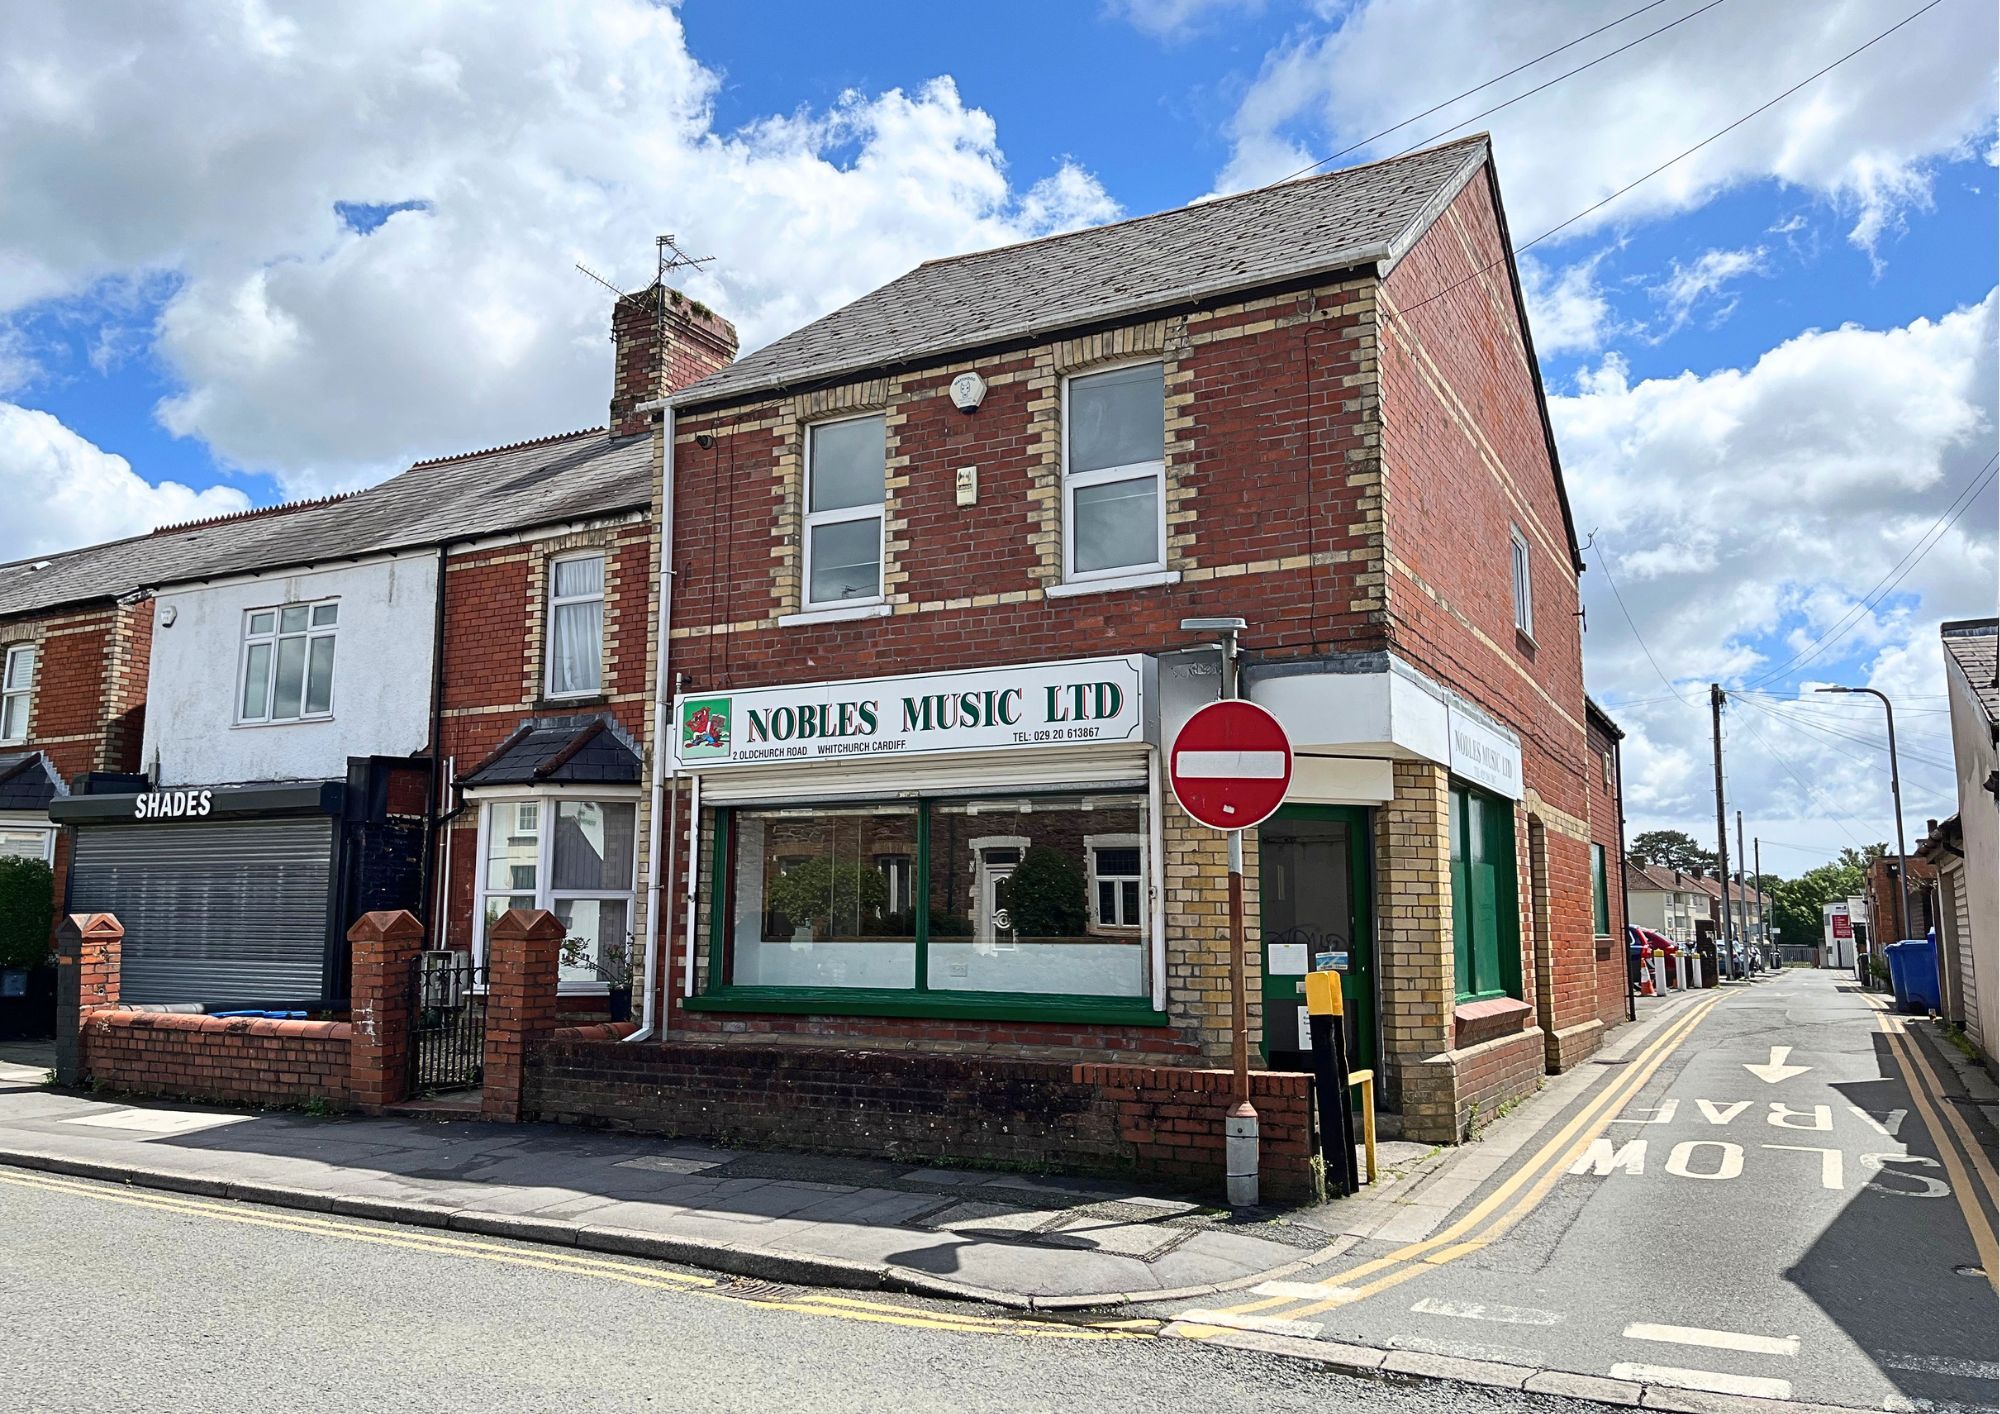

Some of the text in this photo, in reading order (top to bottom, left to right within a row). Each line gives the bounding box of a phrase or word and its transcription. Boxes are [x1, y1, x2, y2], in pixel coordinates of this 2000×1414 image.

[746, 681, 1124, 743] NOBLES MUSIC LTD
[732, 751, 738, 760] 2
[739, 748, 784, 760] OLDCHURCH
[786, 746, 807, 757] ROAD
[817, 742, 870, 755] WHITCHURCH
[1013, 731, 1031, 742] TEL:
[1053, 728, 1063, 739] 20
[1067, 727, 1100, 738] 613867
[1455, 729, 1481, 763] NOBLES
[1482, 744, 1501, 773] MUSIC
[1502, 755, 1513, 779] LTD
[134, 789, 212, 819] SHADES
[1605, 1098, 1908, 1135] ARAF
[1567, 1139, 1951, 1198] SLOW
